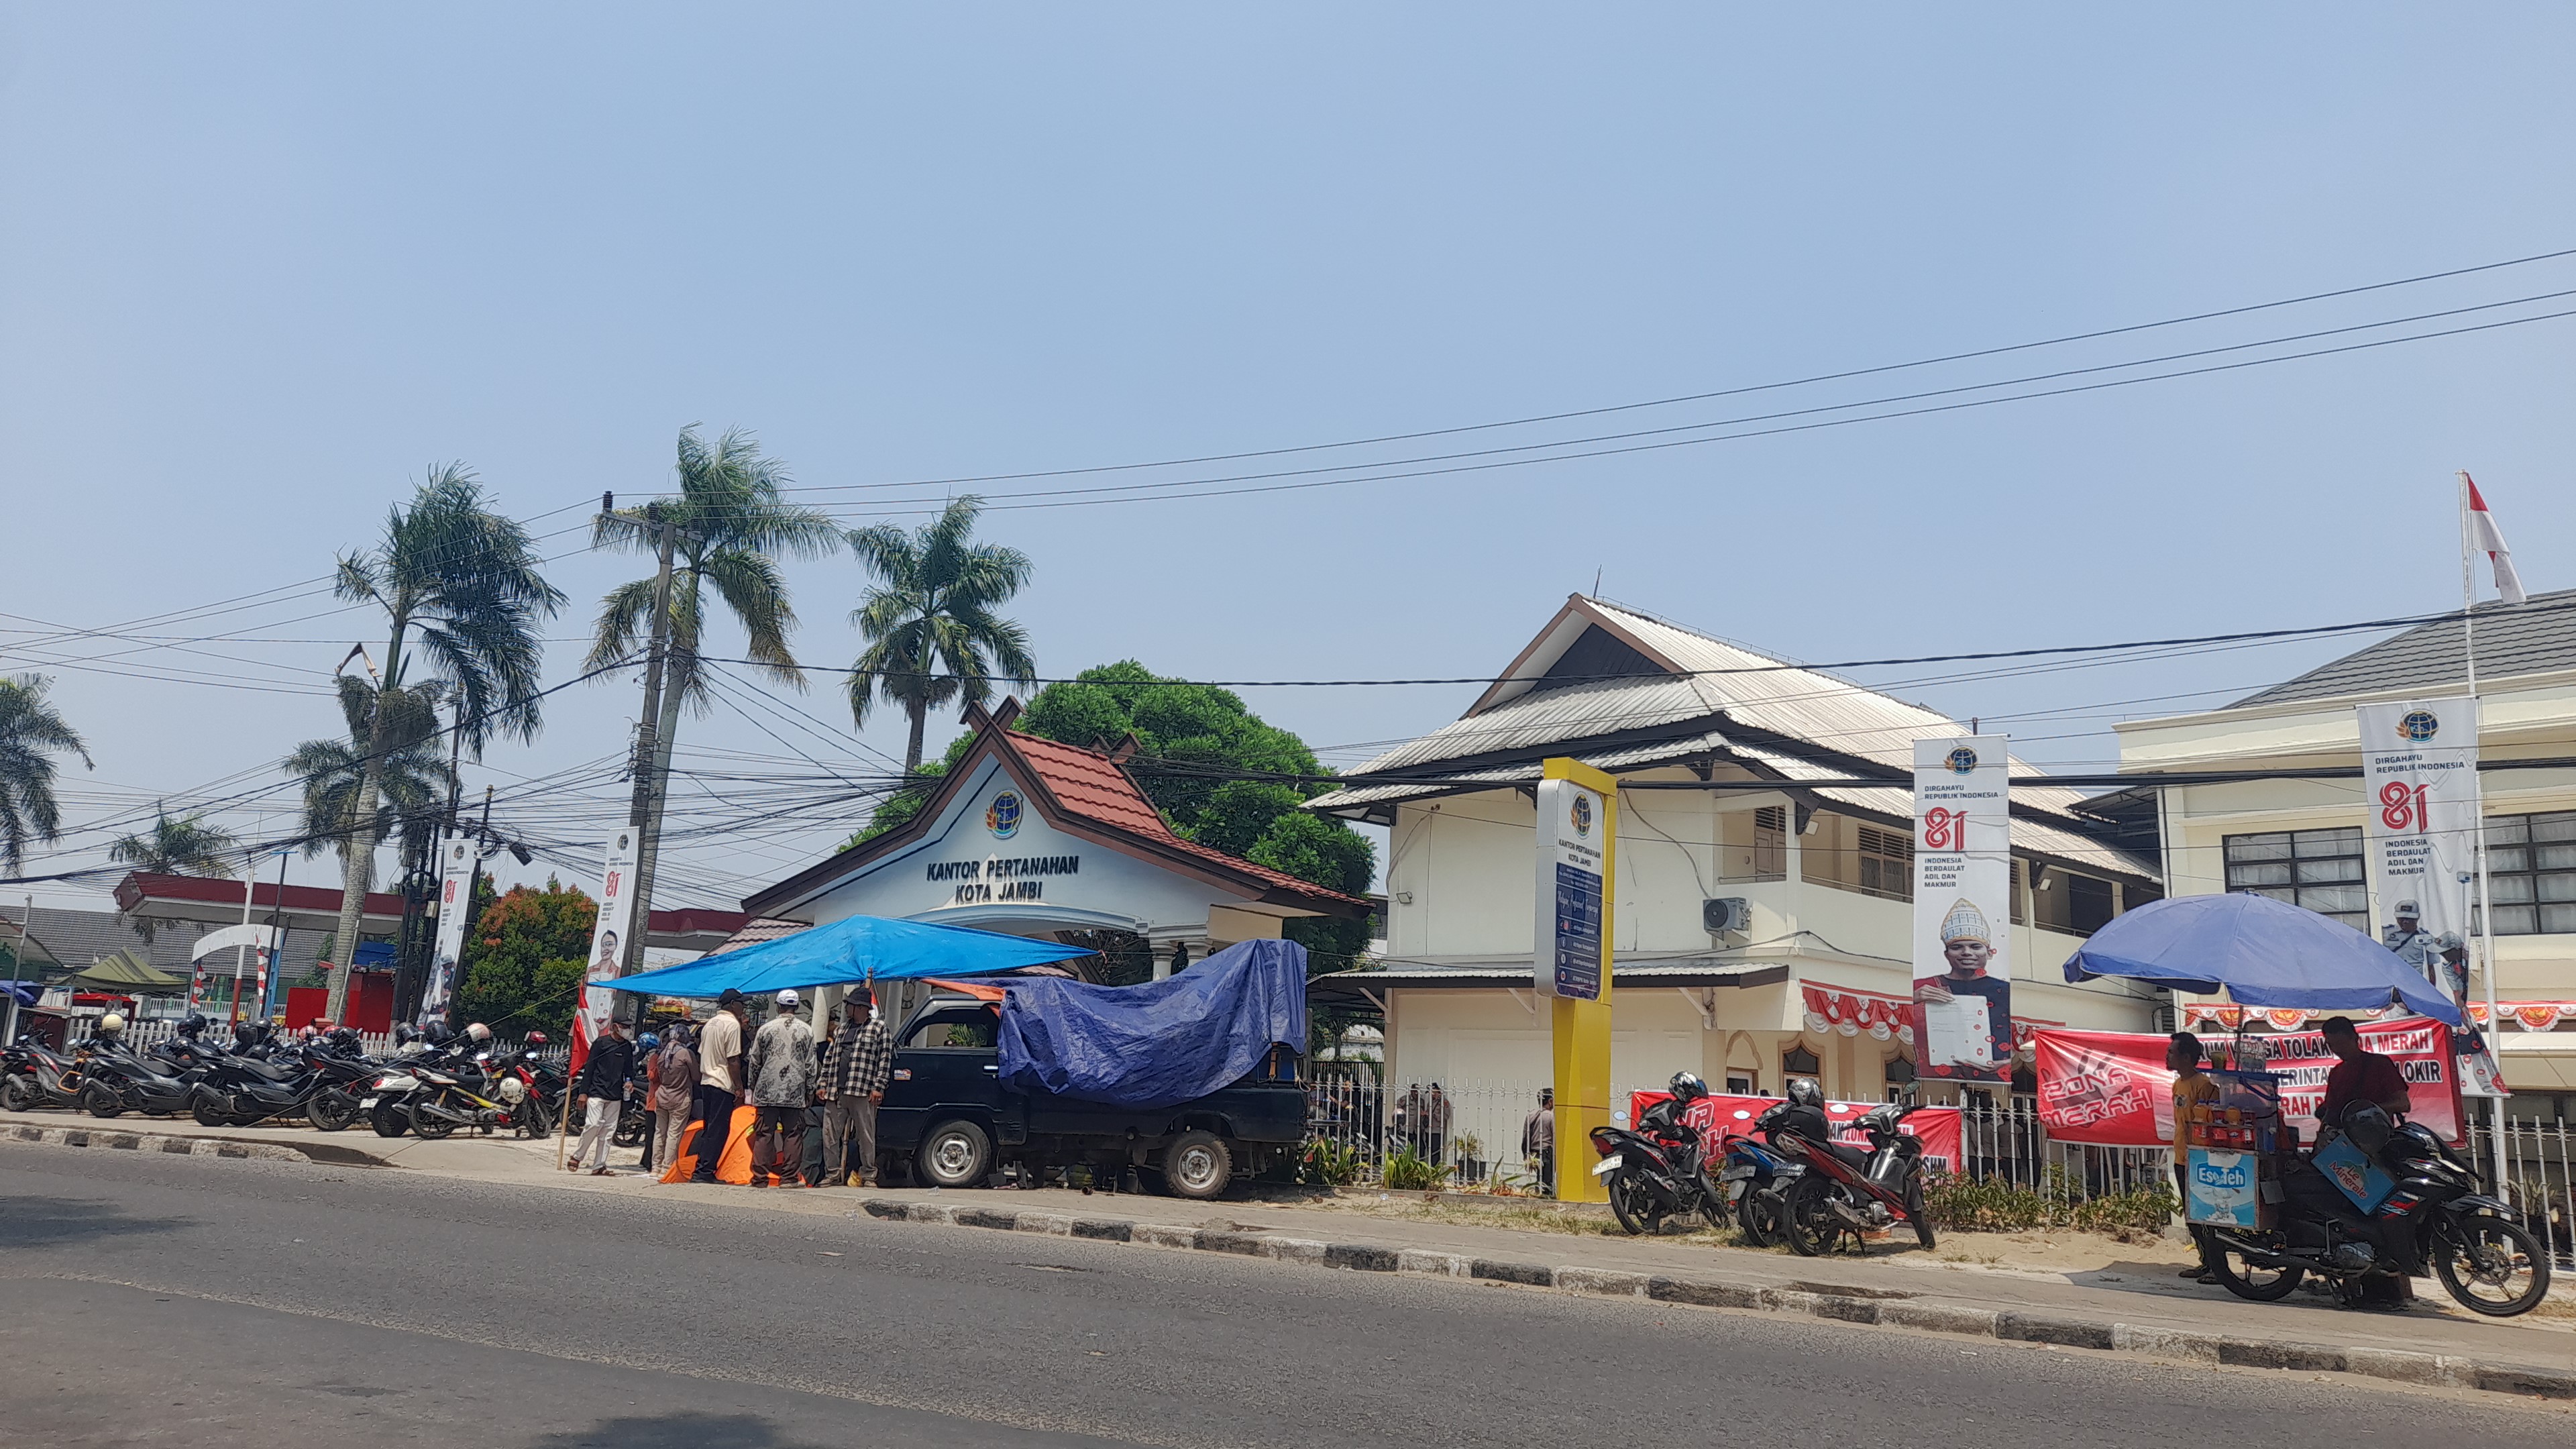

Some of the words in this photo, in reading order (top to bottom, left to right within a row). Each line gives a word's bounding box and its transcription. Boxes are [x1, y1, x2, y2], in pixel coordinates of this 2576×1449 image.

[2375, 754, 2422, 764] DIRGAHAYU
[2376, 764, 2416, 773] REPUBLIK
[2418, 762, 2465, 770] INDONESIA
[2379, 782, 2430, 834] 81
[1925, 807, 1969, 853] 81
[1559, 839, 1574, 850] KANTOR
[2385, 839, 2428, 848] INDONESIA
[2386, 847, 2431, 857] BERDAULAT
[926, 861, 980, 881] KANTOR
[986, 855, 1079, 877] PERTANAHAN
[1568, 853, 1578, 863] KOTA
[2389, 867, 2425, 875] MAKMUR
[606, 871, 622, 897] 81
[955, 883, 991, 903] KOTA
[998, 881, 1043, 900] JAMBI
[2284, 1036, 2333, 1059] TOLAK
[2377, 1031, 2430, 1052] MERAH
[2042, 1067, 2131, 1102] ZONA
[2040, 1088, 2152, 1129] MERAH
[2282, 1095, 2311, 1116] RAH
[2329, 1161, 2368, 1199] Minerale
[2347, 1165, 2361, 1181] Le
